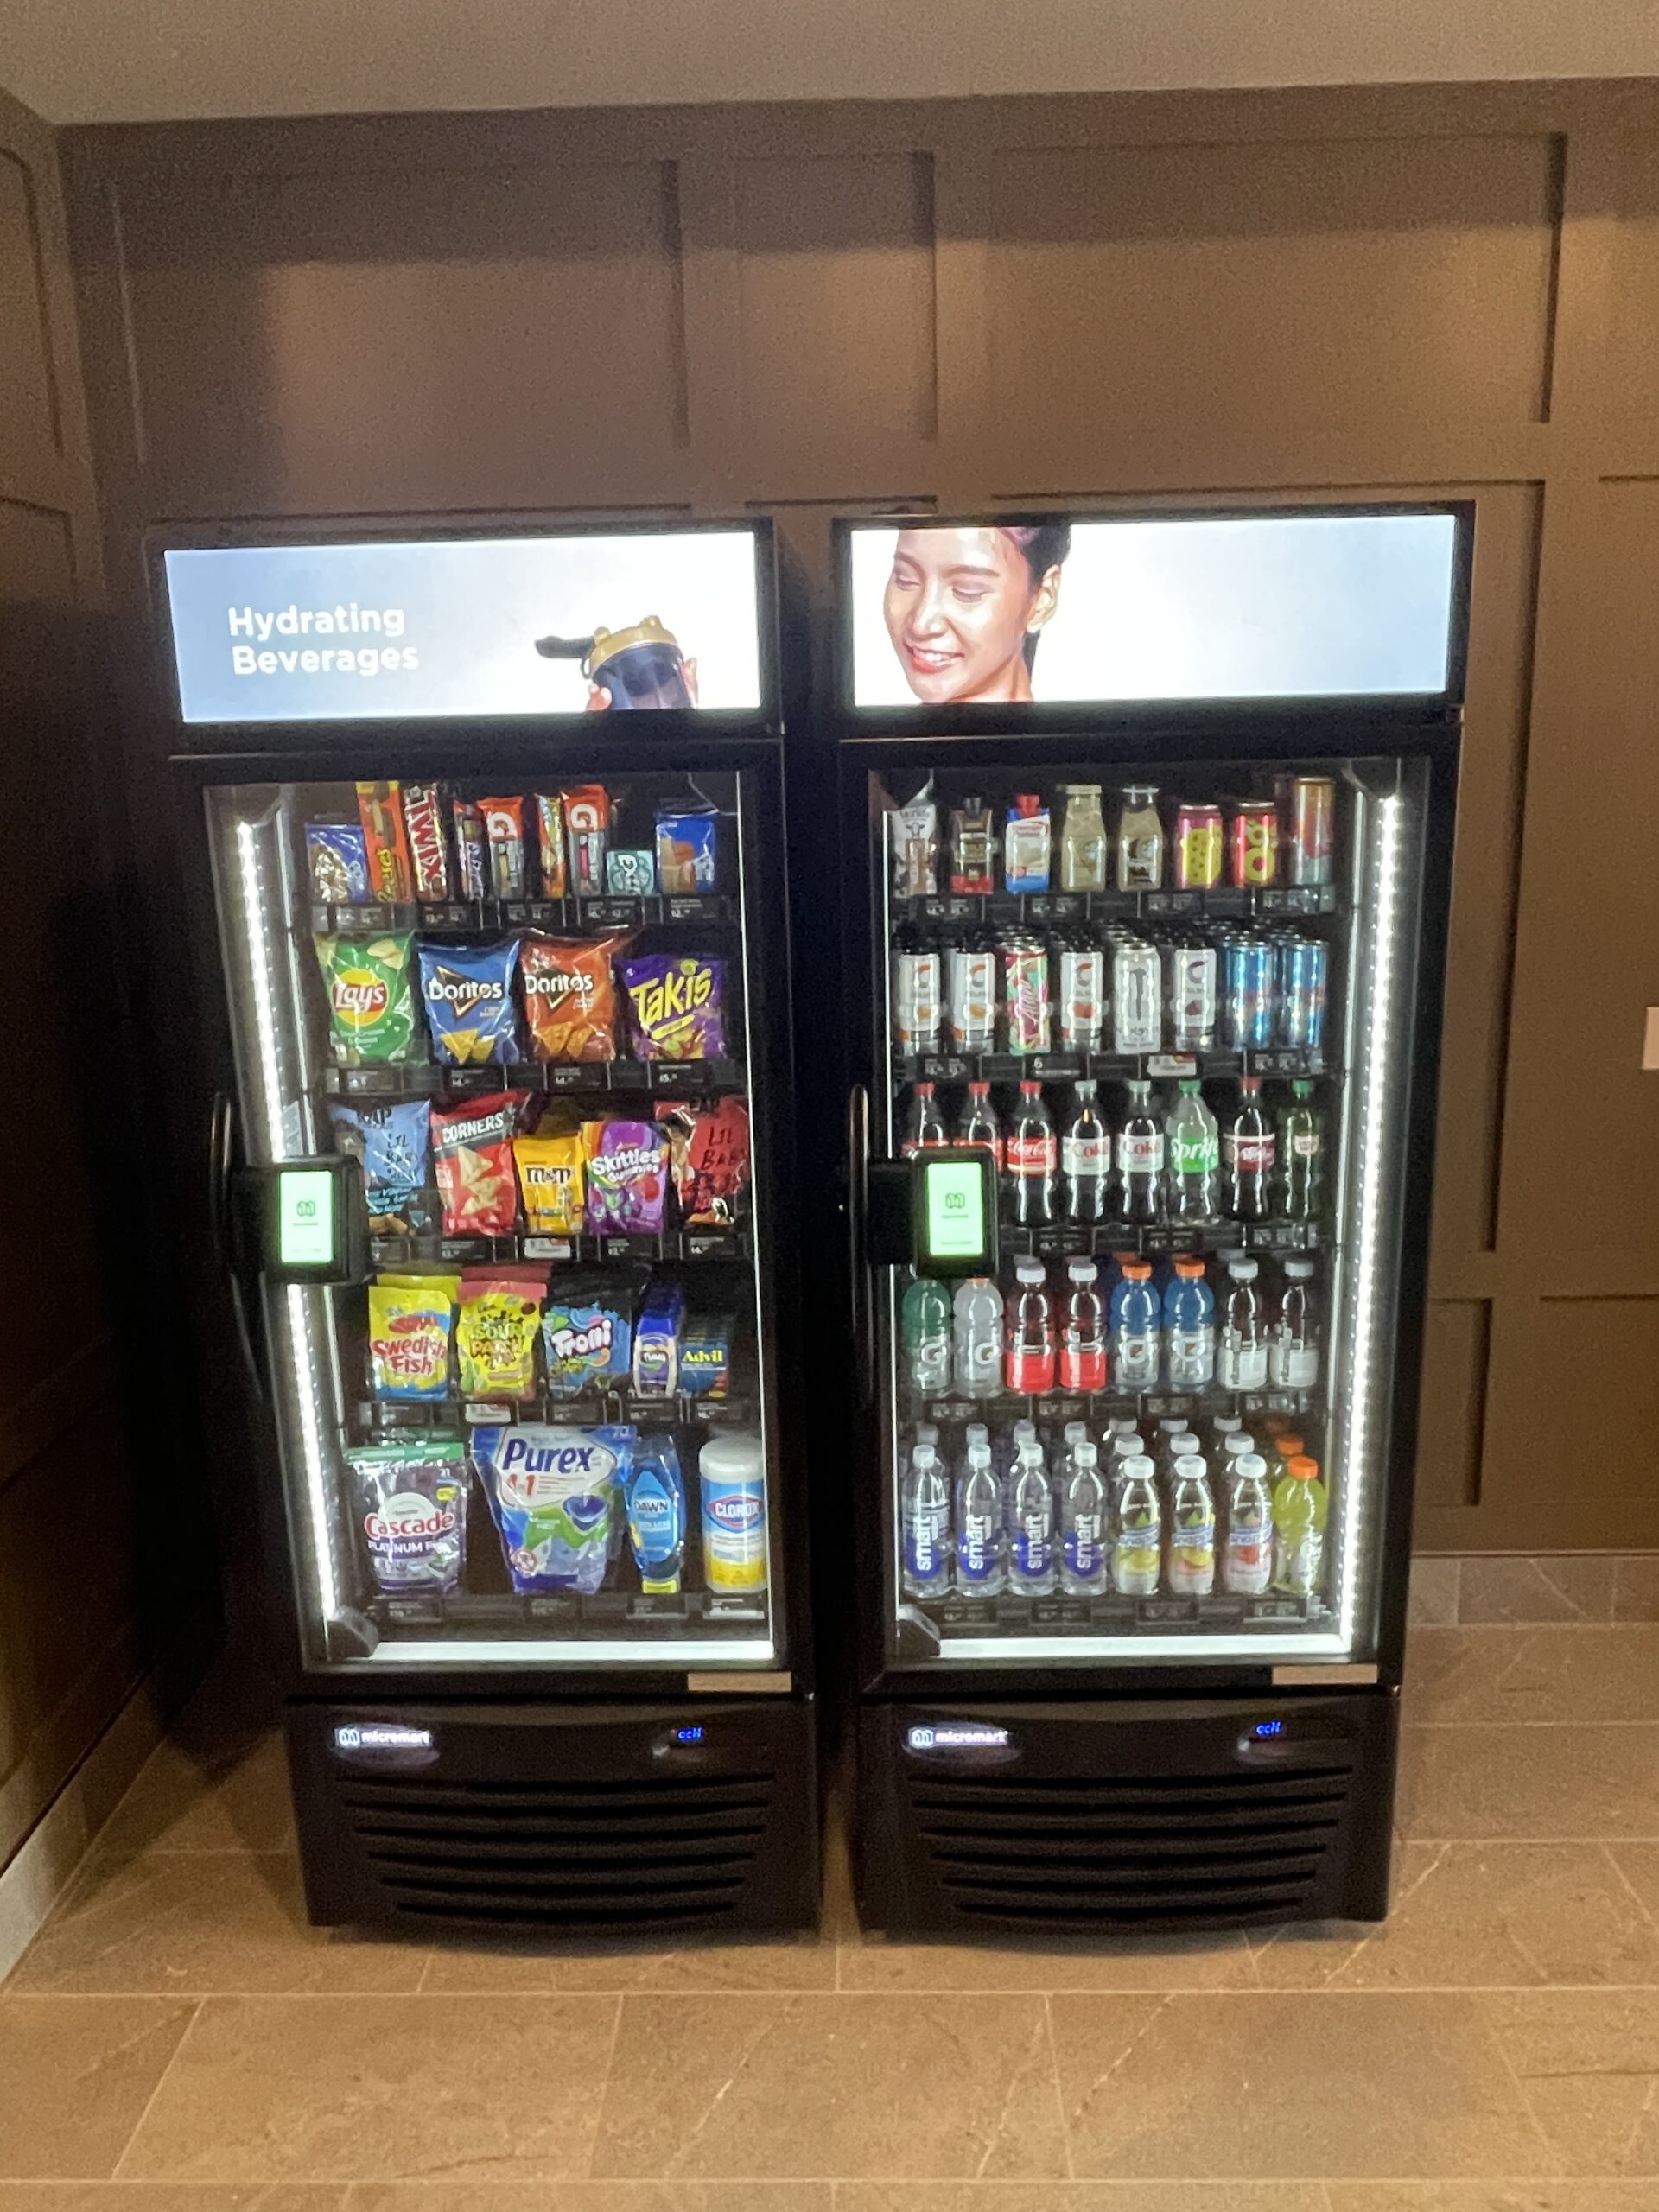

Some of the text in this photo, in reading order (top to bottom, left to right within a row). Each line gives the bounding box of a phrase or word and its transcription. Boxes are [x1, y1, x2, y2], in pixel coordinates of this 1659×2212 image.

[228, 604, 405, 642] Hydrating
[232, 643, 419, 677] Beverages
[405, 790, 442, 884] TWIX
[429, 979, 503, 1001] Doritos
[524, 974, 594, 995] Doritos
[629, 959, 713, 1032] Takis
[442, 1112, 505, 1143] CORNERS
[592, 1148, 661, 1175] Skittles
[372, 1336, 447, 1360] Swedish
[550, 1319, 612, 1358] Trolli
[390, 1356, 433, 1375] Fish
[683, 1350, 723, 1363] Advil
[503, 1438, 594, 1474] Purex
[634, 1500, 669, 1512] DAWN
[365, 1509, 455, 1539] Cascade
[367, 1541, 423, 1553] PLATNUM
[966, 1515, 983, 1570] smart
[1026, 1514, 1043, 1569] smart
[1075, 1514, 1093, 1569] smart
